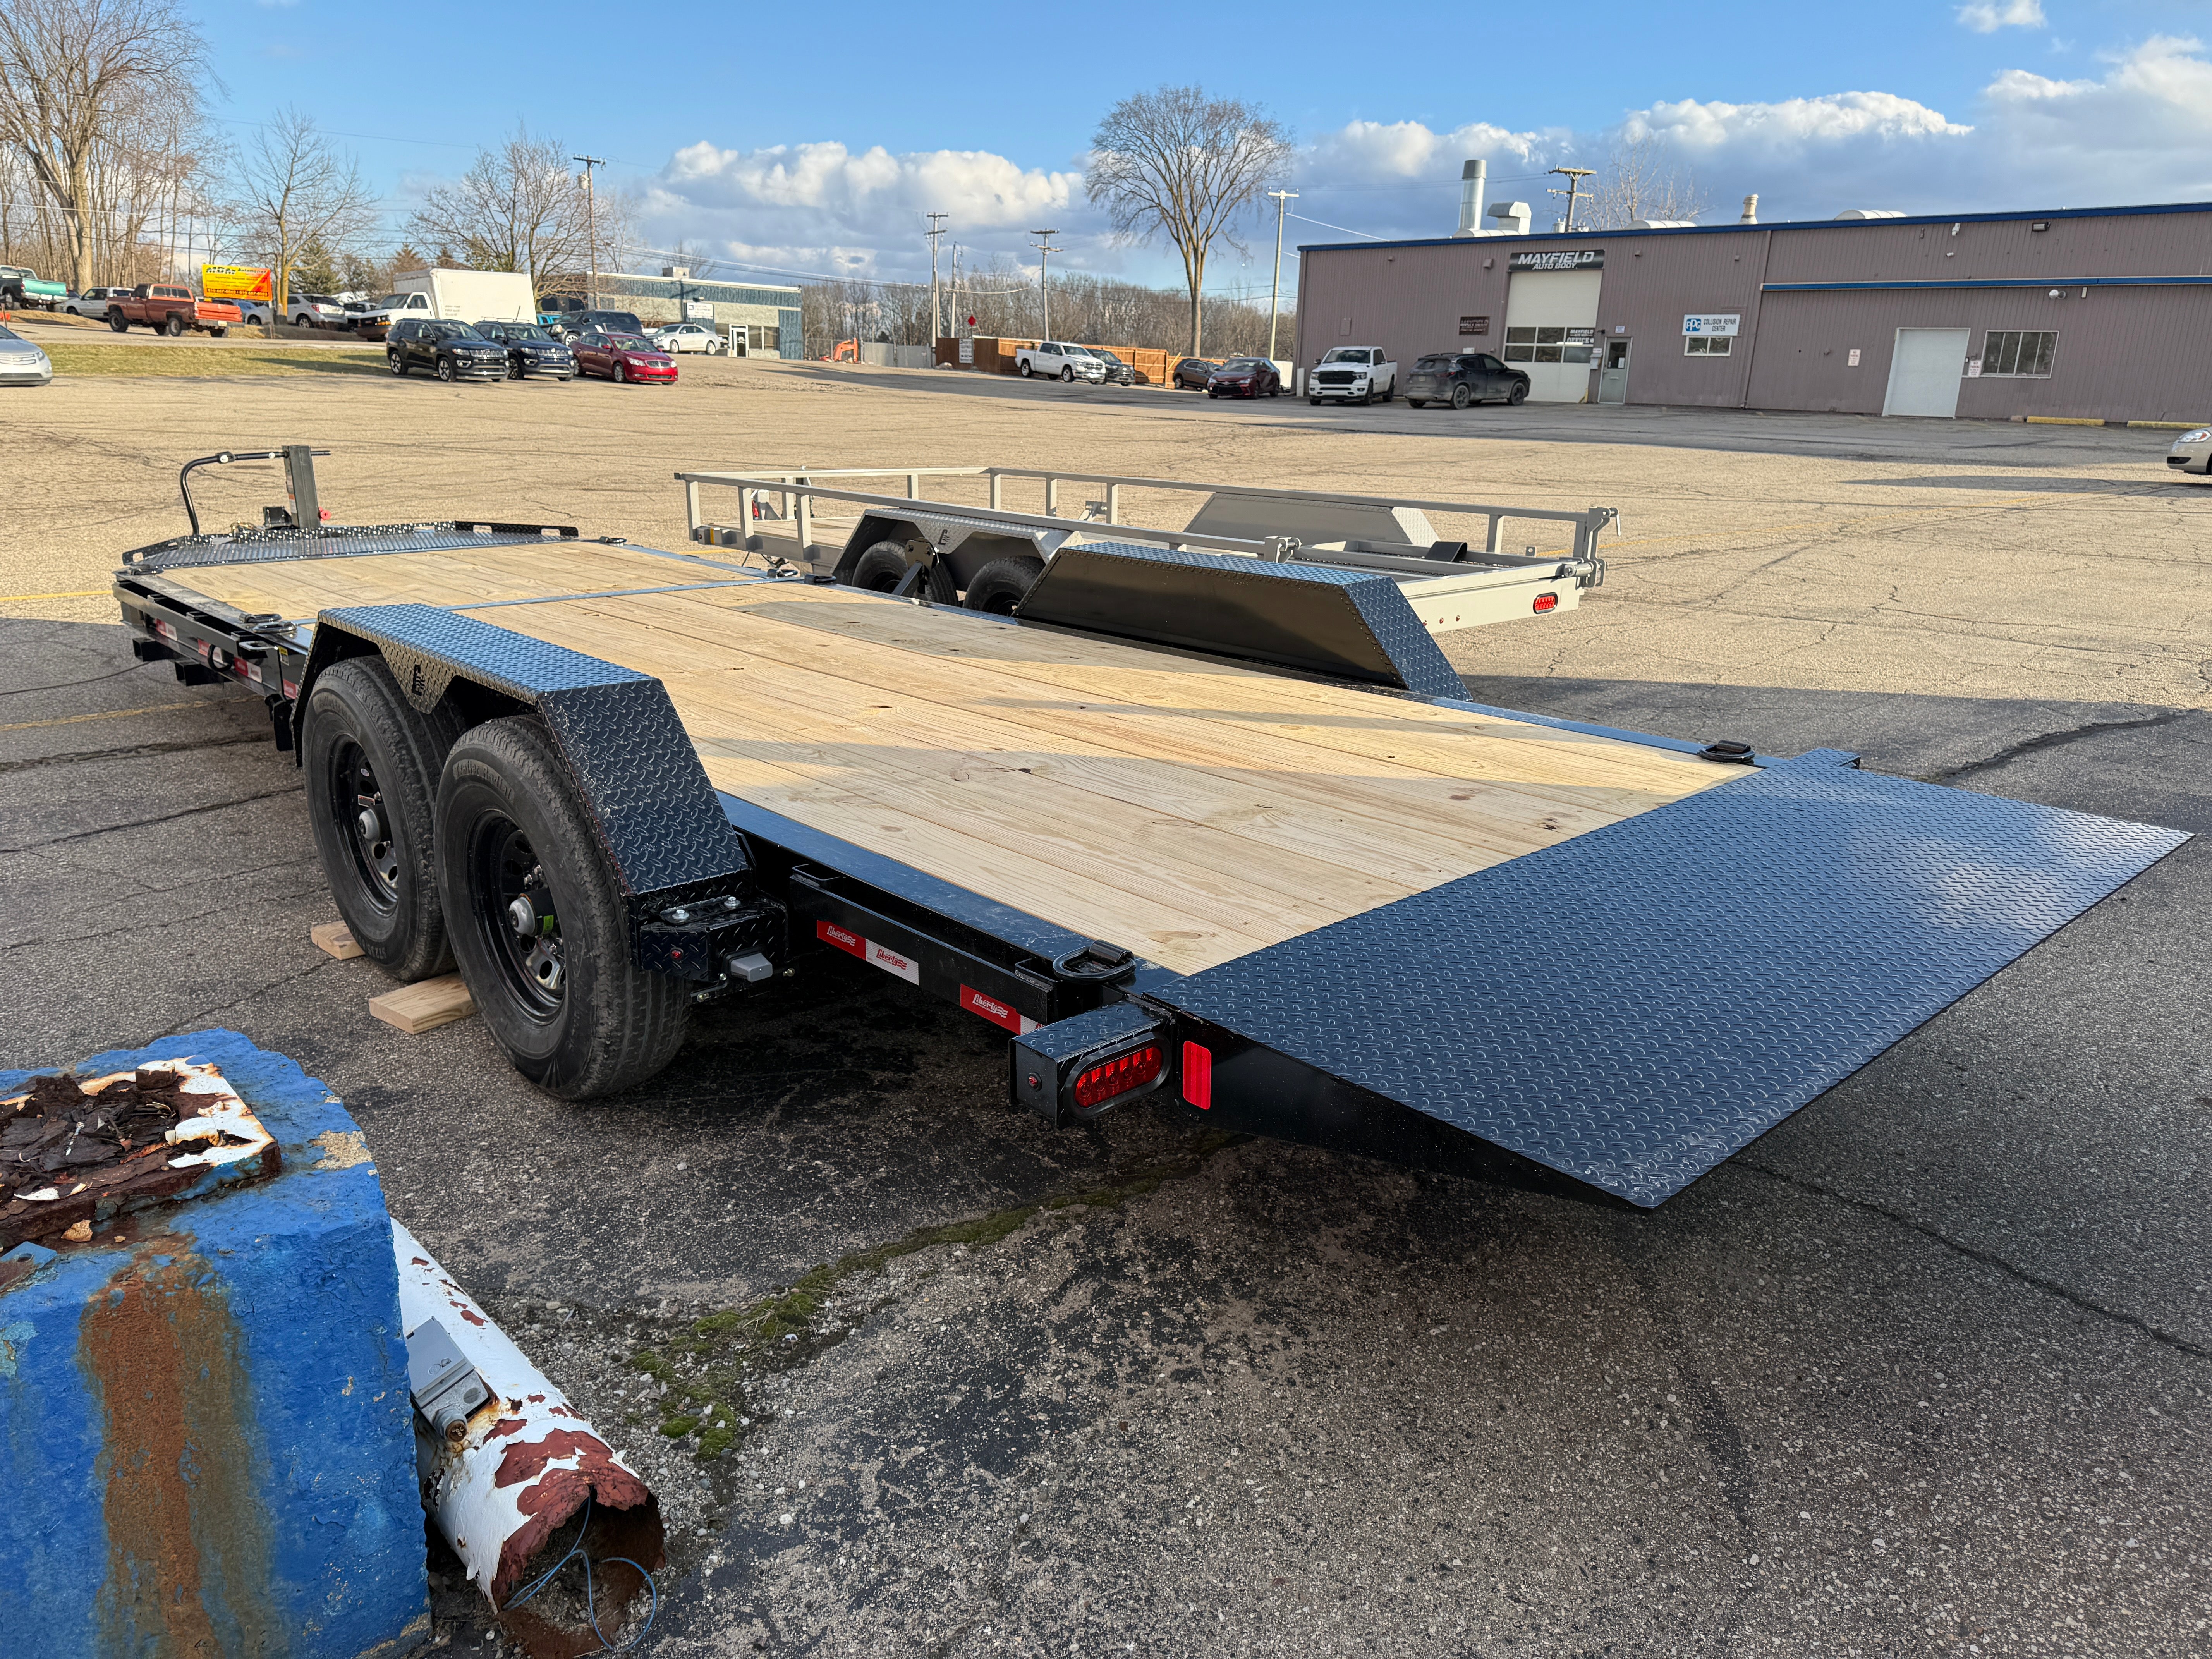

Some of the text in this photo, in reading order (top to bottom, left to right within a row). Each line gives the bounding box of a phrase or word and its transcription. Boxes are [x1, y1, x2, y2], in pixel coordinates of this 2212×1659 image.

[1518, 251, 1595, 264] MAYFIELD
[1686, 319, 1701, 331] PPG
[454, 760, 512, 799] Trailer Radial
[827, 925, 848, 943] Liberty
[876, 948, 898, 966] Liberty
[972, 993, 998, 1014] Liberty
